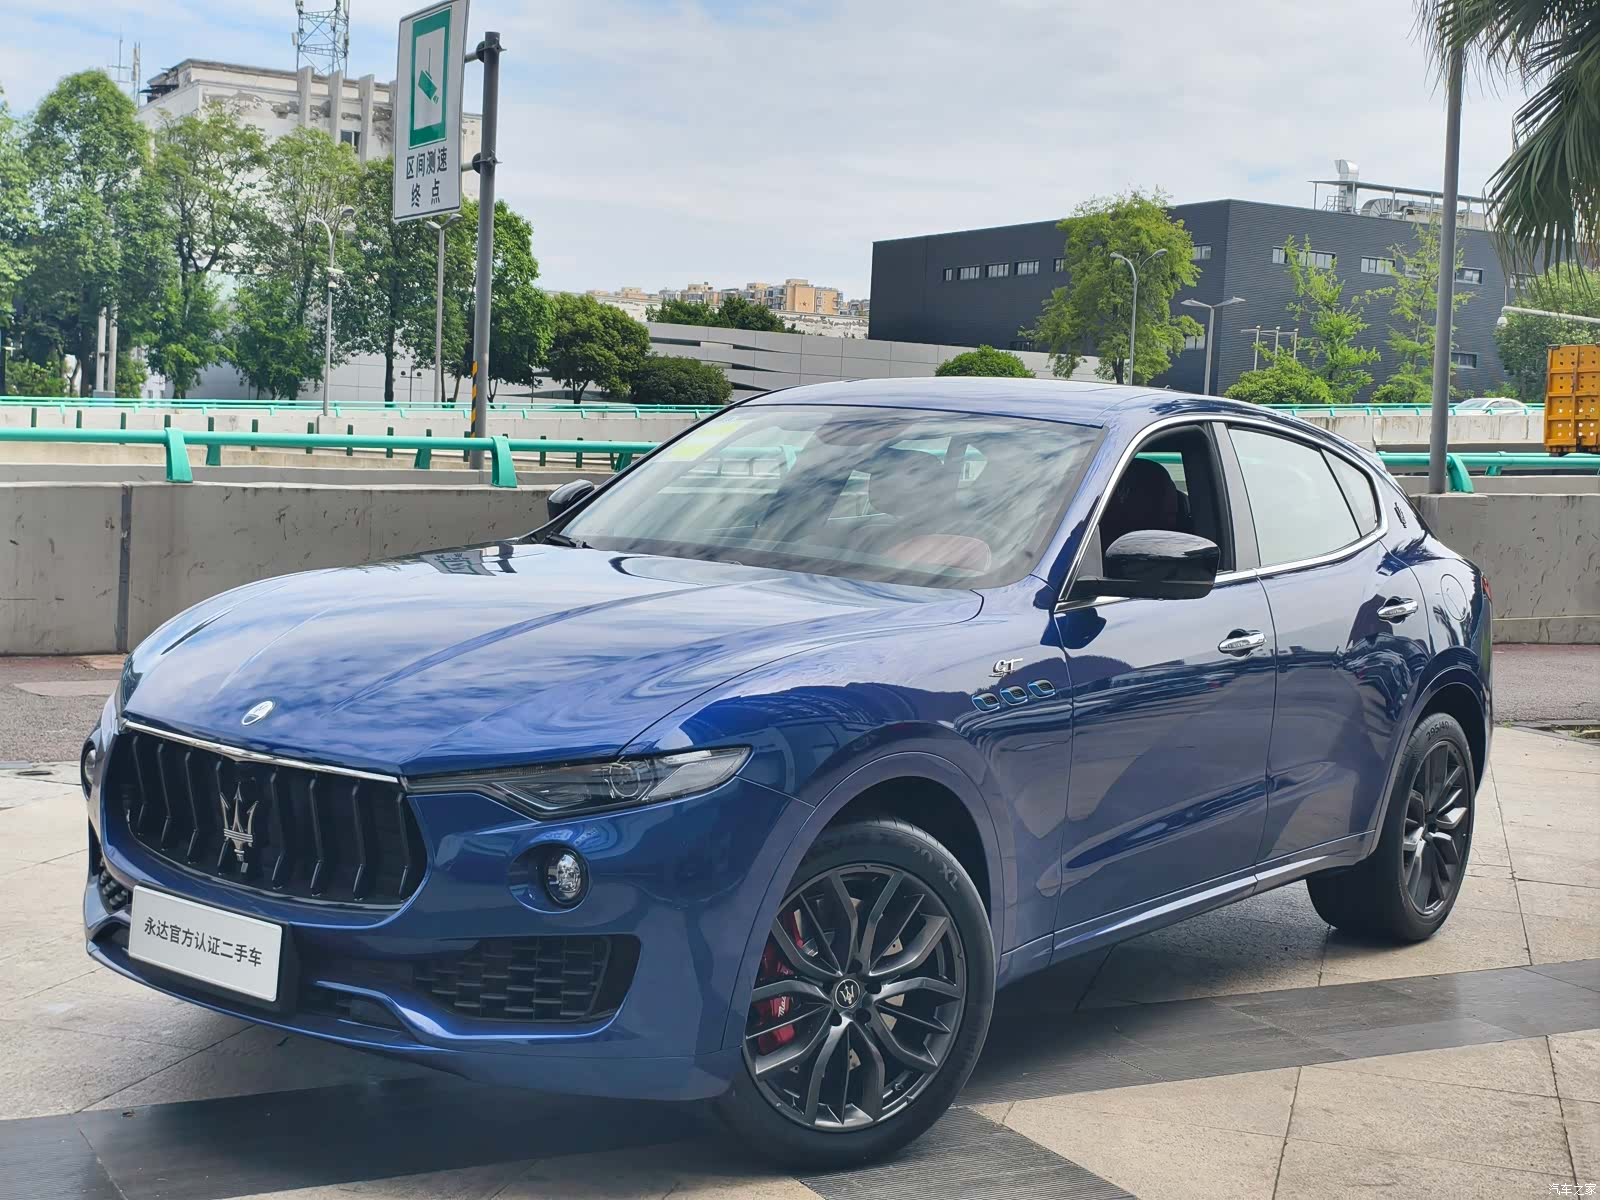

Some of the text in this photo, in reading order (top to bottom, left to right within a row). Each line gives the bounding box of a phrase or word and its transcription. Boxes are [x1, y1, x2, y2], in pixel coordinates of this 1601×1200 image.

[406, 146, 448, 180] 区间测速
[411, 178, 441, 208] 终点
[989, 658, 1023, 677] GT
[144, 916, 263, 967] 永达官方认证二手车
